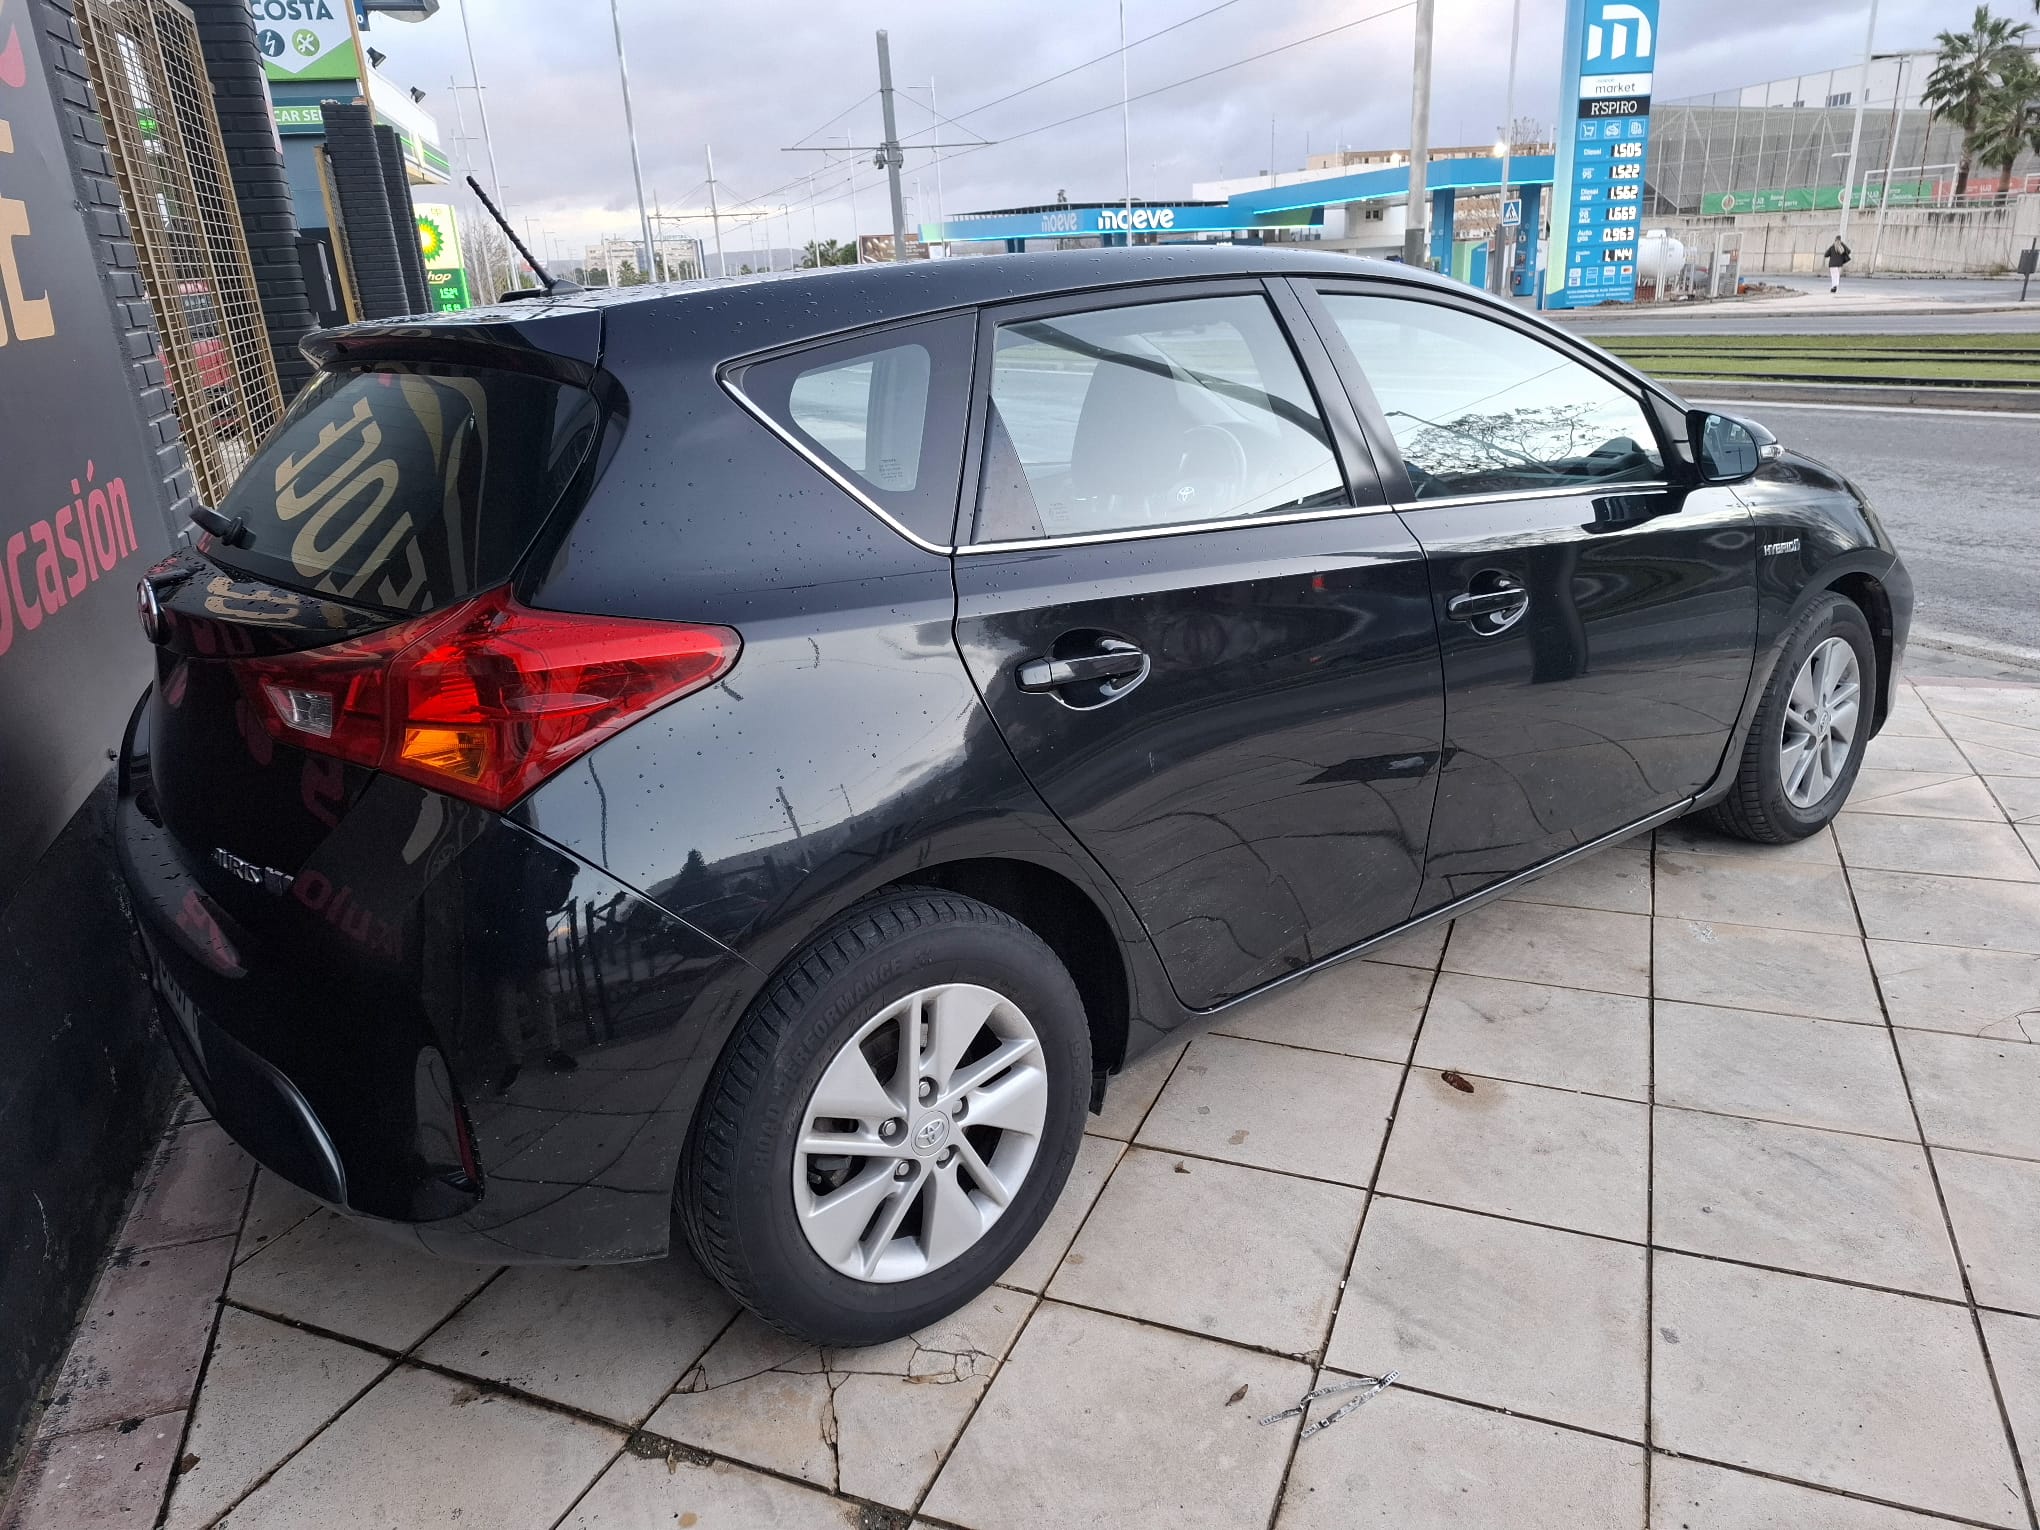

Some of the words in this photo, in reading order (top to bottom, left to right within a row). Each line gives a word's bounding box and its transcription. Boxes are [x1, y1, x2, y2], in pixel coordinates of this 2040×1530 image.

[1595, 82, 1636, 94] market
[274, 110, 301, 122] CAR
[1041, 212, 1077, 232] moeve
[1097, 208, 1174, 230] moeve
[427, 271, 451, 281] hop
